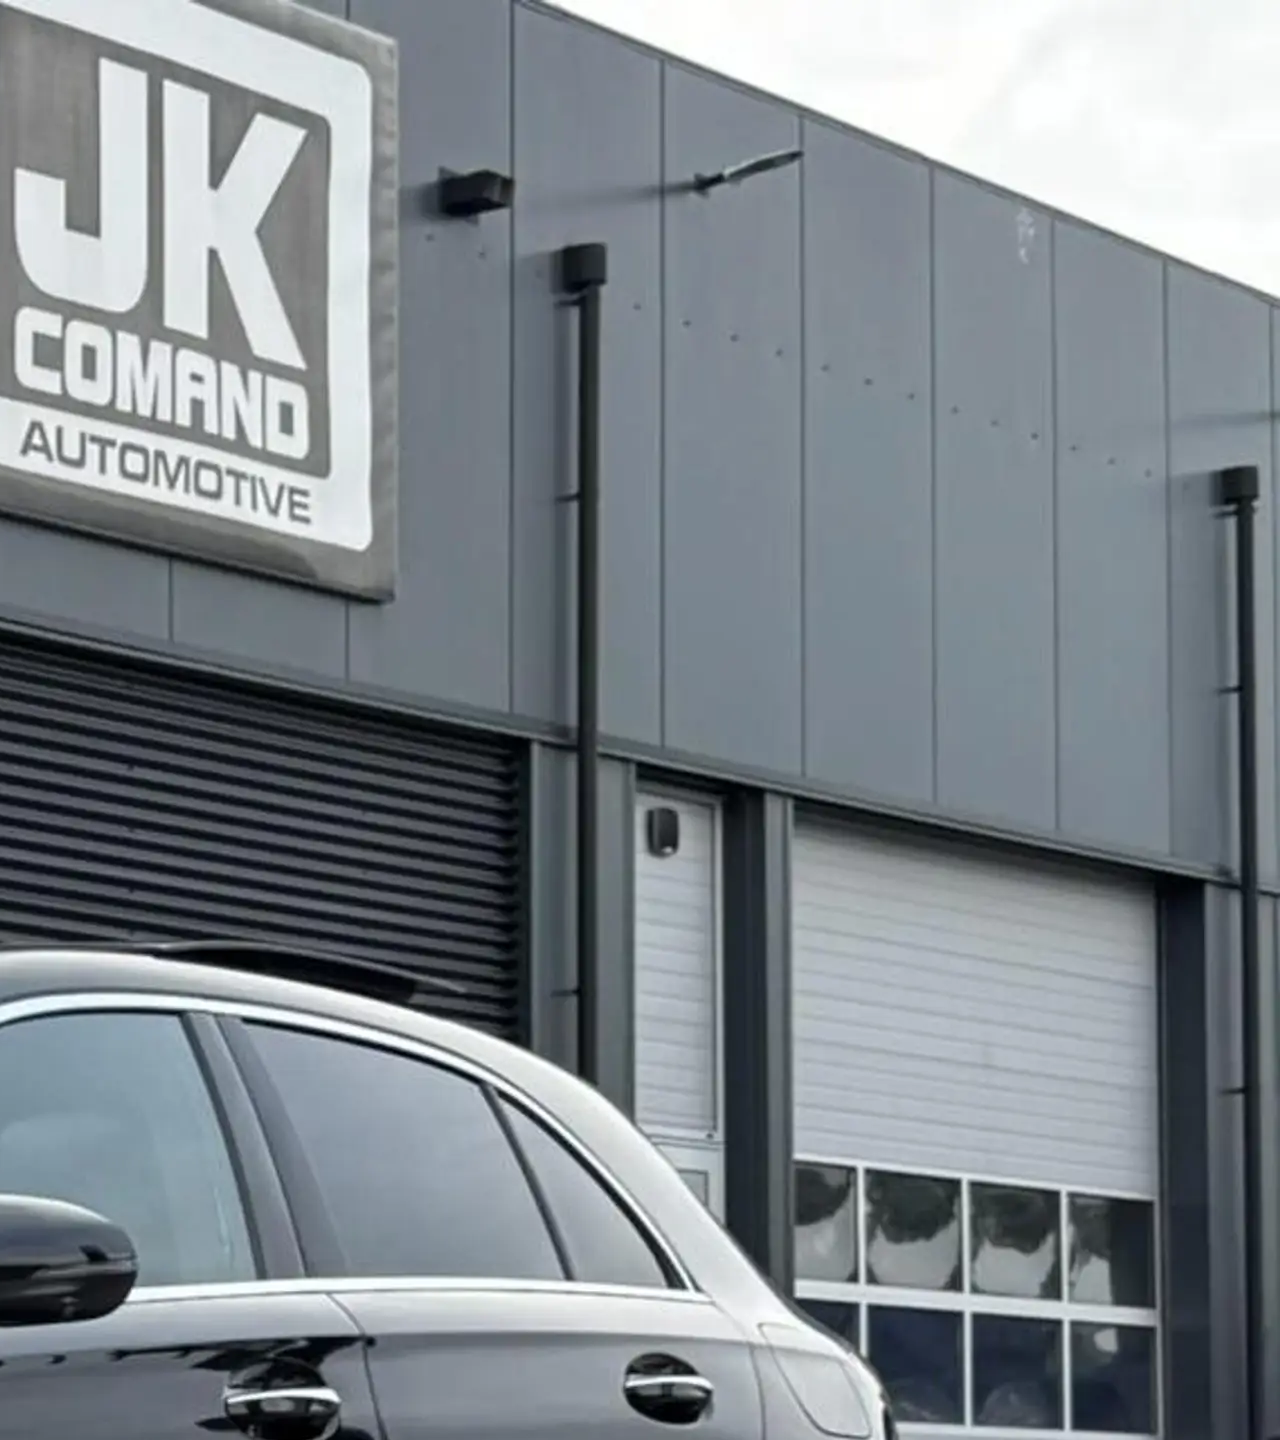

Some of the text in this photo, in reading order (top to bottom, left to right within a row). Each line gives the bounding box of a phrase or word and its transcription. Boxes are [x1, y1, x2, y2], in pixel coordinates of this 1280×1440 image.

[14, 56, 308, 371] JK
[14, 306, 310, 460] COMAND
[20, 420, 312, 524] AUTOMOTIVE
